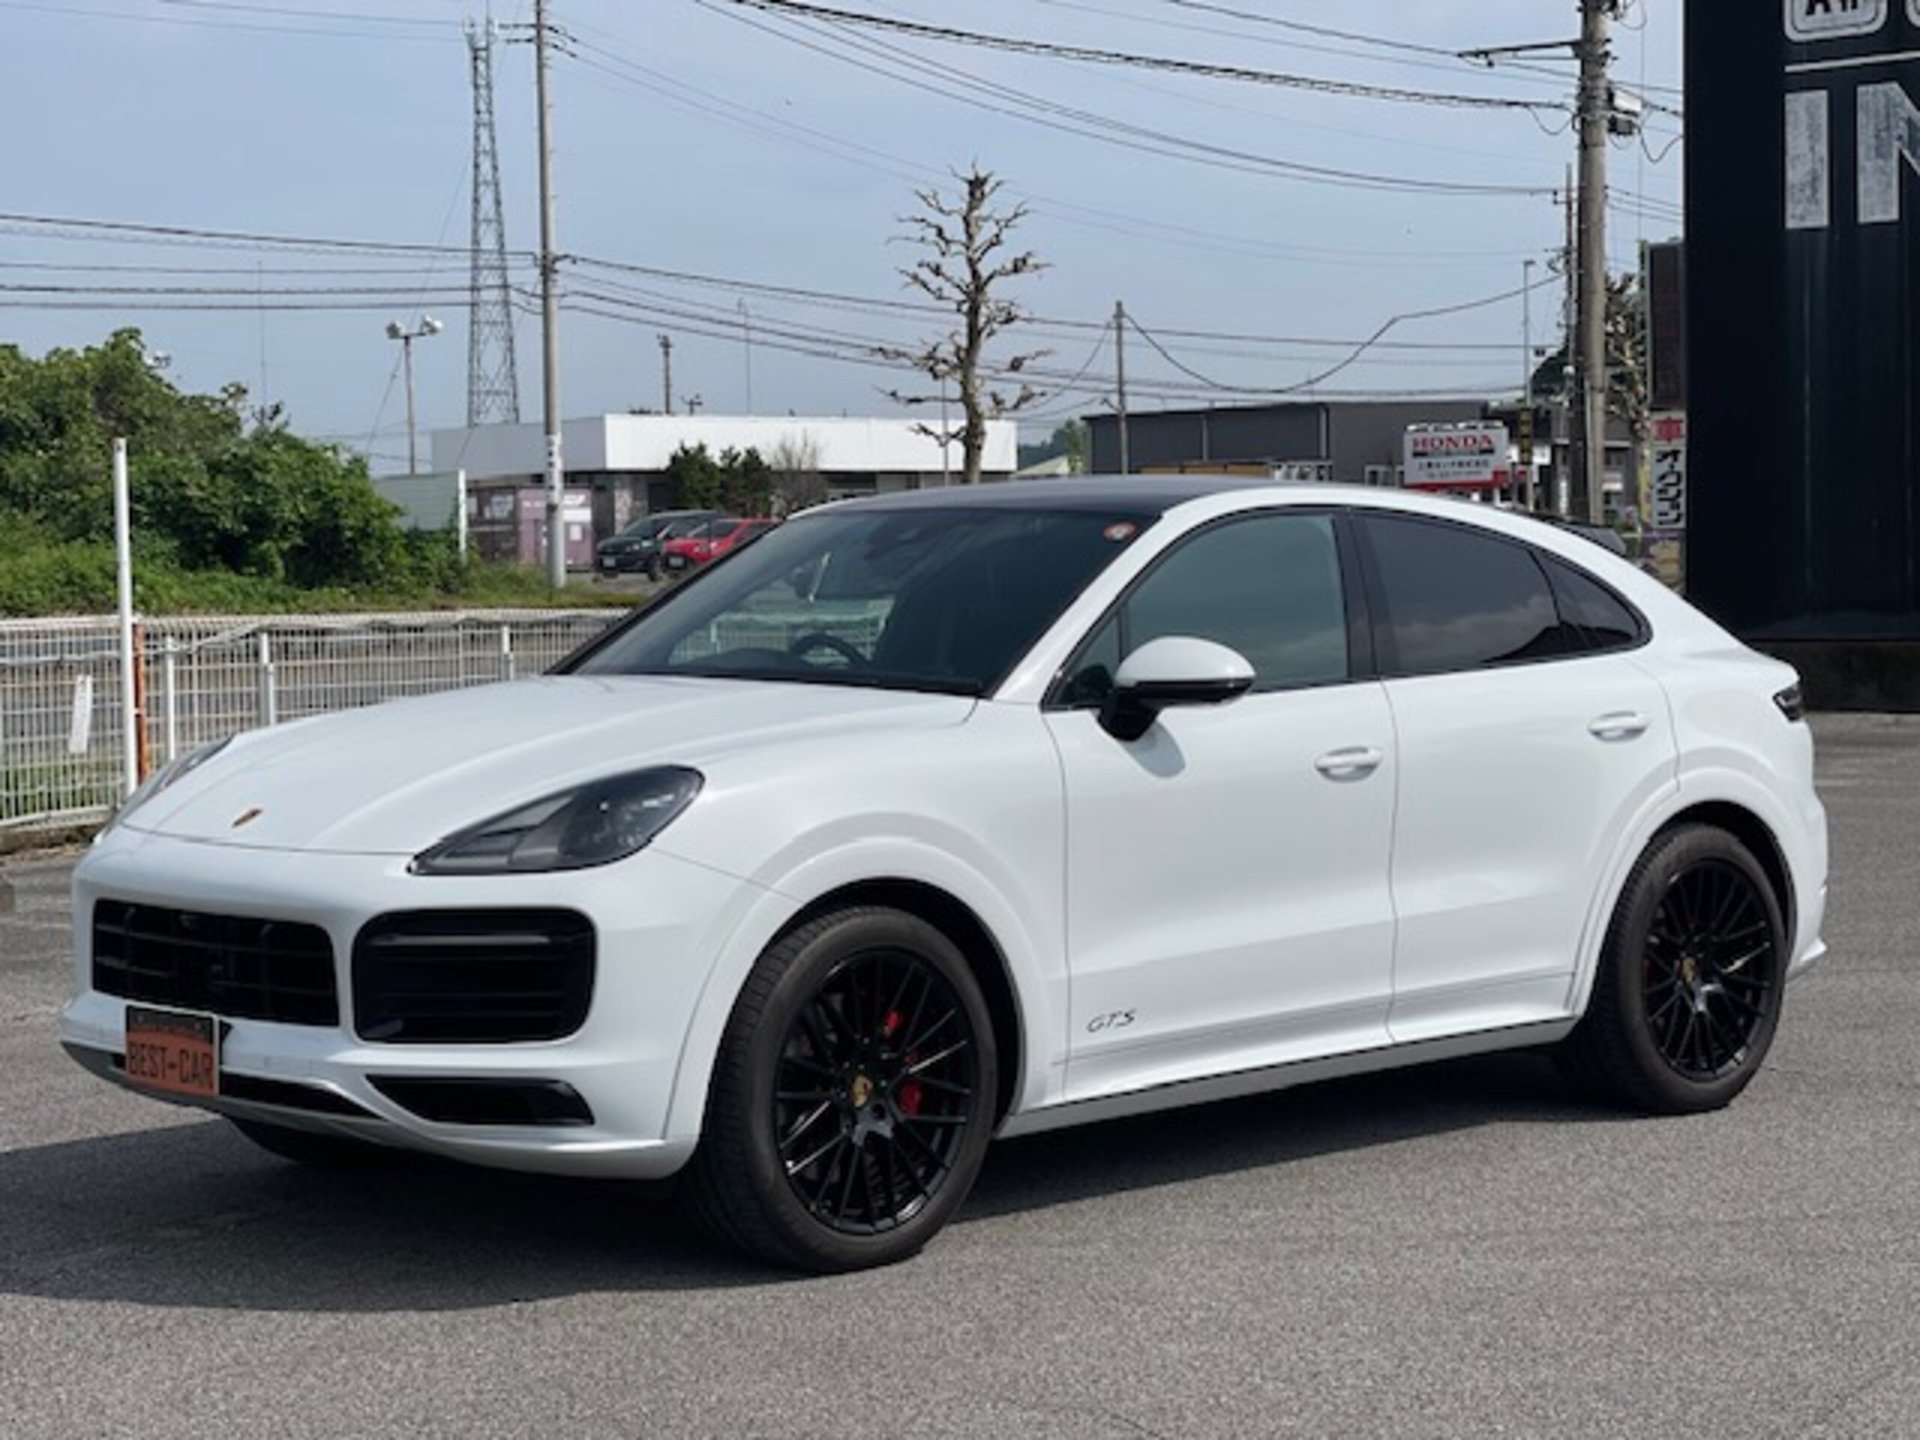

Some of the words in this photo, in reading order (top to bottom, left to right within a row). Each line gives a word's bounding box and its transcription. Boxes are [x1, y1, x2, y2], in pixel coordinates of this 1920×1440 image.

[1412, 434, 1493, 451] HONDA
[1086, 1009, 1136, 1033] GTS
[128, 1040, 214, 1092] BEST-CAR
